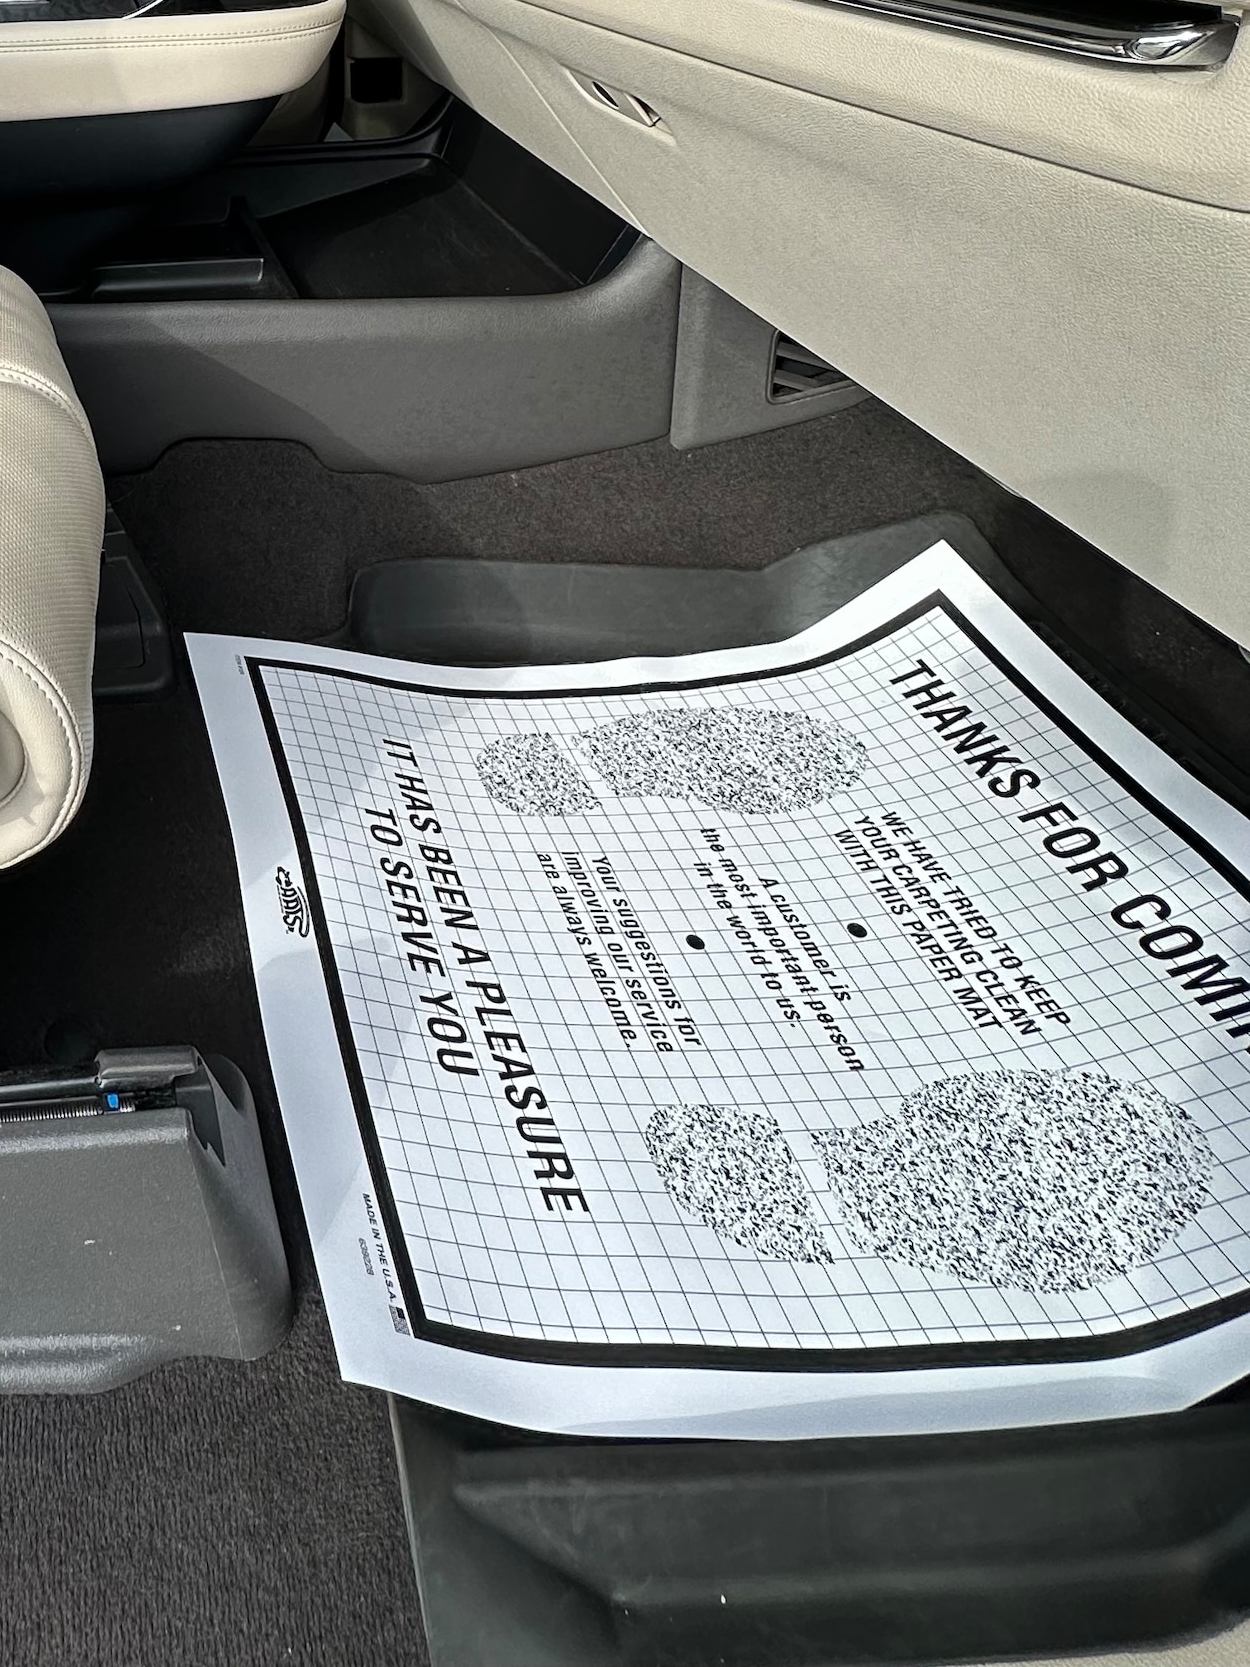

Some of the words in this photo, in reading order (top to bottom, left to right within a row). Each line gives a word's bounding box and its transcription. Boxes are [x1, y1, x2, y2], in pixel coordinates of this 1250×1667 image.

[382, 738, 418, 770] IT
[394, 770, 441, 835] HAS
[365, 807, 403, 848] TO
[418, 842, 480, 931] BEEN
[889, 659, 1041, 798] THANKS
[1018, 801, 1129, 892] FOR
[1111, 893, 1250, 1054] COMI
[380, 856, 446, 977] SERVE
[452, 941, 491, 965] A
[537, 853, 559, 879] are
[553, 886, 592, 946] always
[584, 952, 637, 1048] welcome.
[561, 851, 615, 935] improving
[607, 942, 635, 972] our
[625, 979, 673, 1052] service
[592, 856, 622, 893] Your
[613, 898, 682, 1010] suggestions
[674, 1017, 702, 1046] for
[693, 862, 714, 877] in
[707, 883, 732, 910] the
[726, 915, 773, 965] world
[761, 972, 783, 990] to
[776, 998, 801, 1028] us.
[700, 828, 725, 852] the
[719, 857, 758, 899] most
[749, 904, 819, 994] important
[803, 1000, 865, 1071] person
[758, 877, 780, 889] A
[771, 894, 837, 978] customer
[829, 983, 851, 1002] is
[834, 829, 880, 872] WITH
[870, 874, 912, 916] THIS
[903, 920, 962, 982] PAPER
[953, 987, 1004, 1029] MAT
[855, 815, 900, 861] YOUR
[892, 865, 983, 966] CARPETING
[976, 970, 1042, 1036] CLEAN
[881, 811, 914, 838] WE
[903, 840, 952, 883] HAVE
[943, 886, 998, 939] TRIED
[991, 943, 1023, 970] TO
[1015, 974, 1071, 1027] KEEP
[419, 992, 479, 1077] YOU
[465, 979, 589, 1213] PLEASURE
[362, 1192, 378, 1227] MADE
[371, 1227, 382, 1240] IN
[375, 1243, 389, 1266] THE
[382, 1268, 397, 1303] U.S.A.
